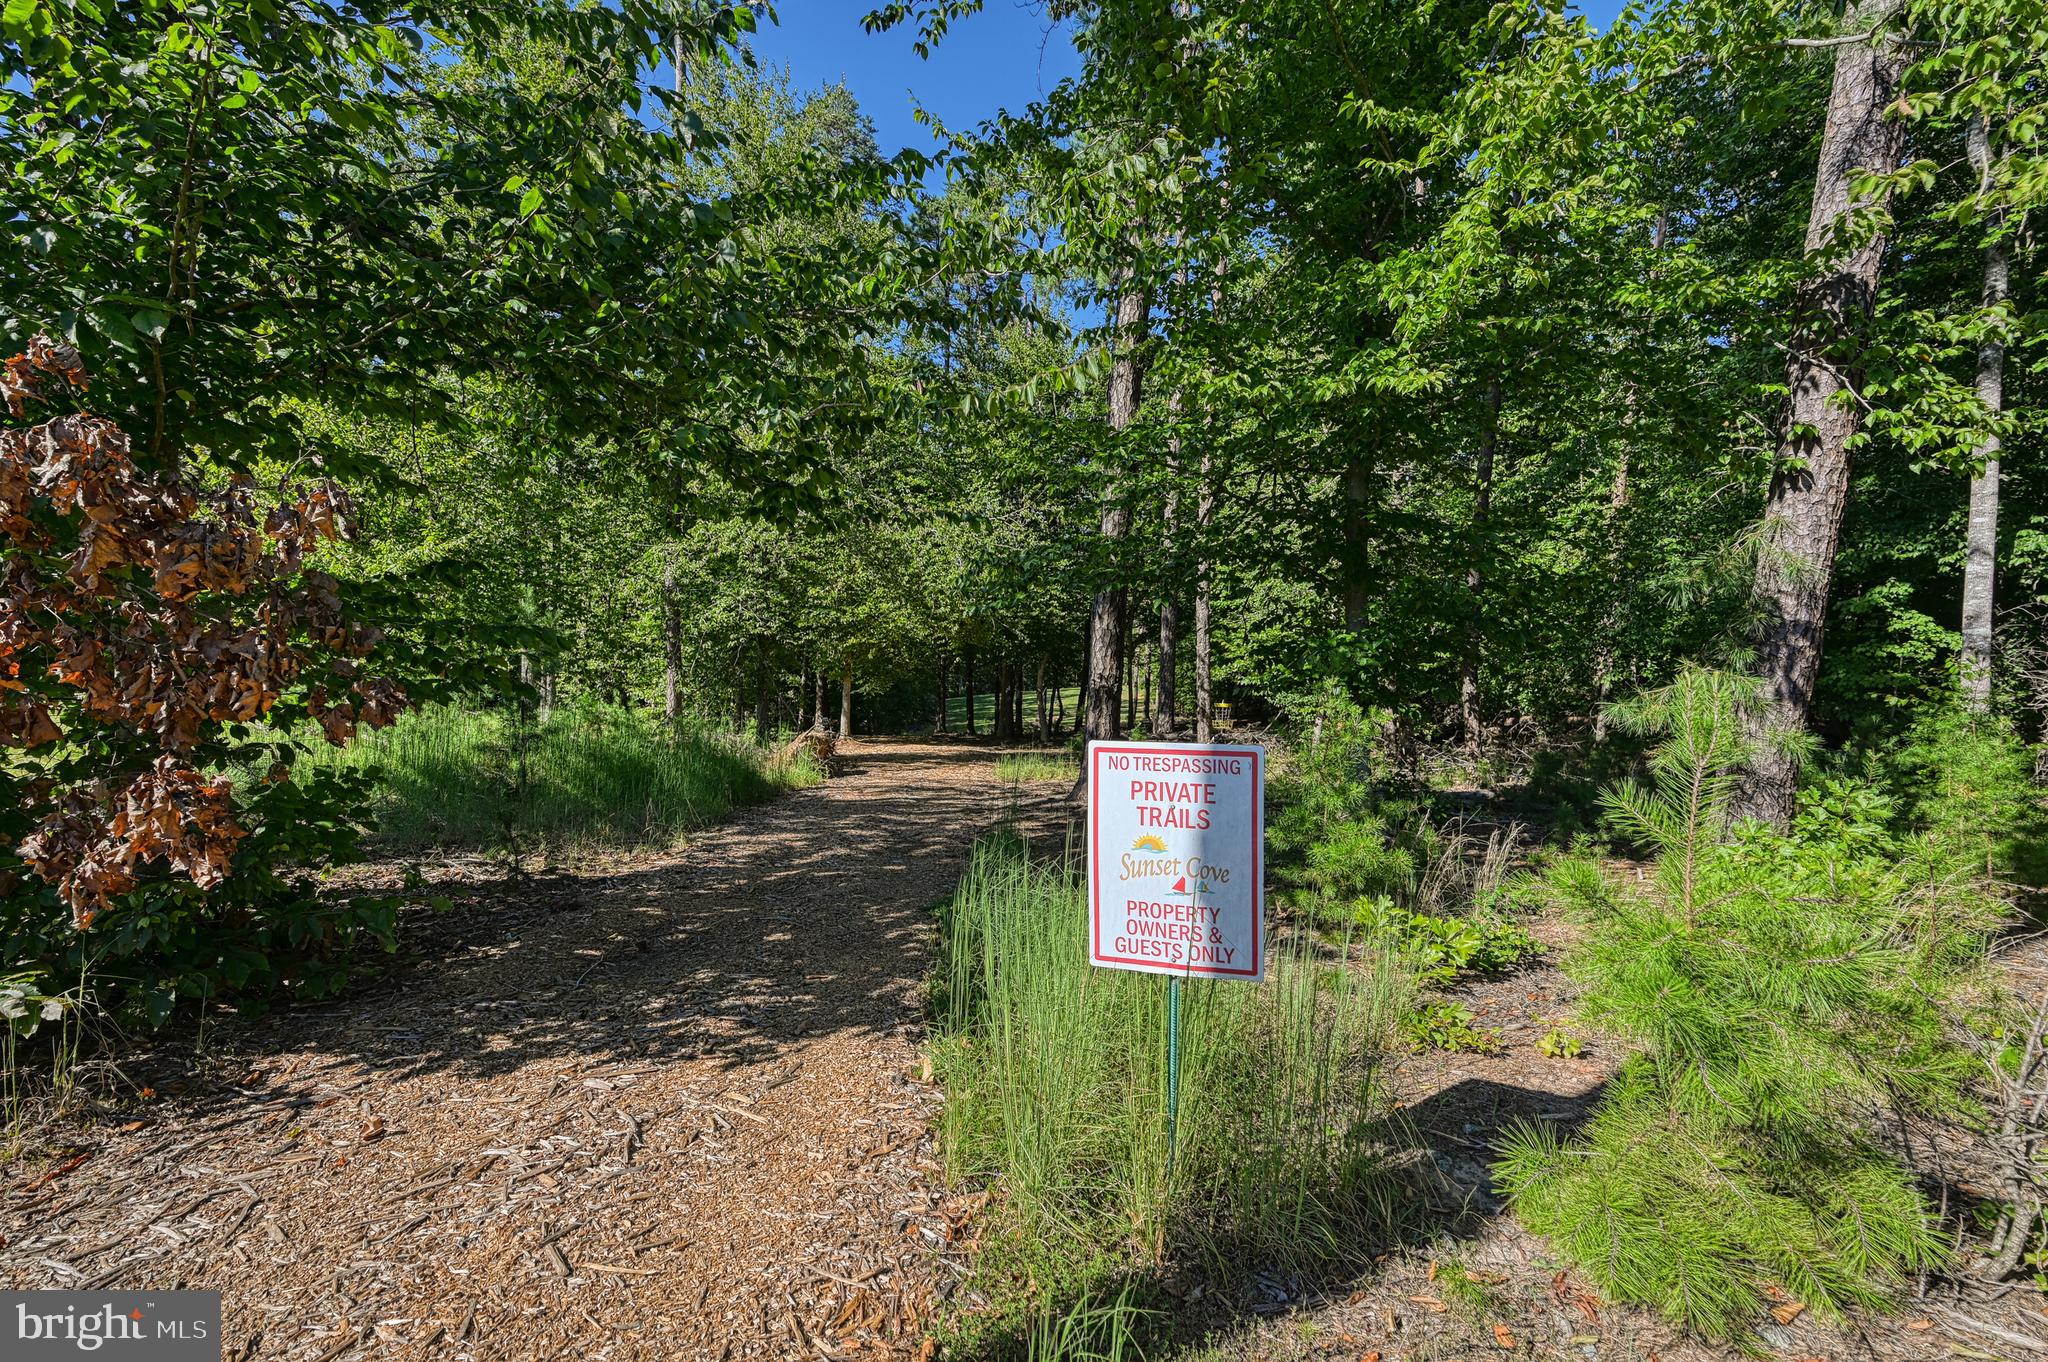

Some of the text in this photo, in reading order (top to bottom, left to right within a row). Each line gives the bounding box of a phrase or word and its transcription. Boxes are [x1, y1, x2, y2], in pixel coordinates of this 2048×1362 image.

[1108, 755, 1241, 775] NO TRESPASSING
[1130, 780, 1216, 804] PRIVATE
[1136, 806, 1211, 830] TRAILS
[1119, 852, 1230, 884] Sunset Cove
[1127, 900, 1221, 924] PROPERTY
[1126, 919, 1223, 944] OWNERS &
[1115, 936, 1235, 964] GUESTS ONLY
